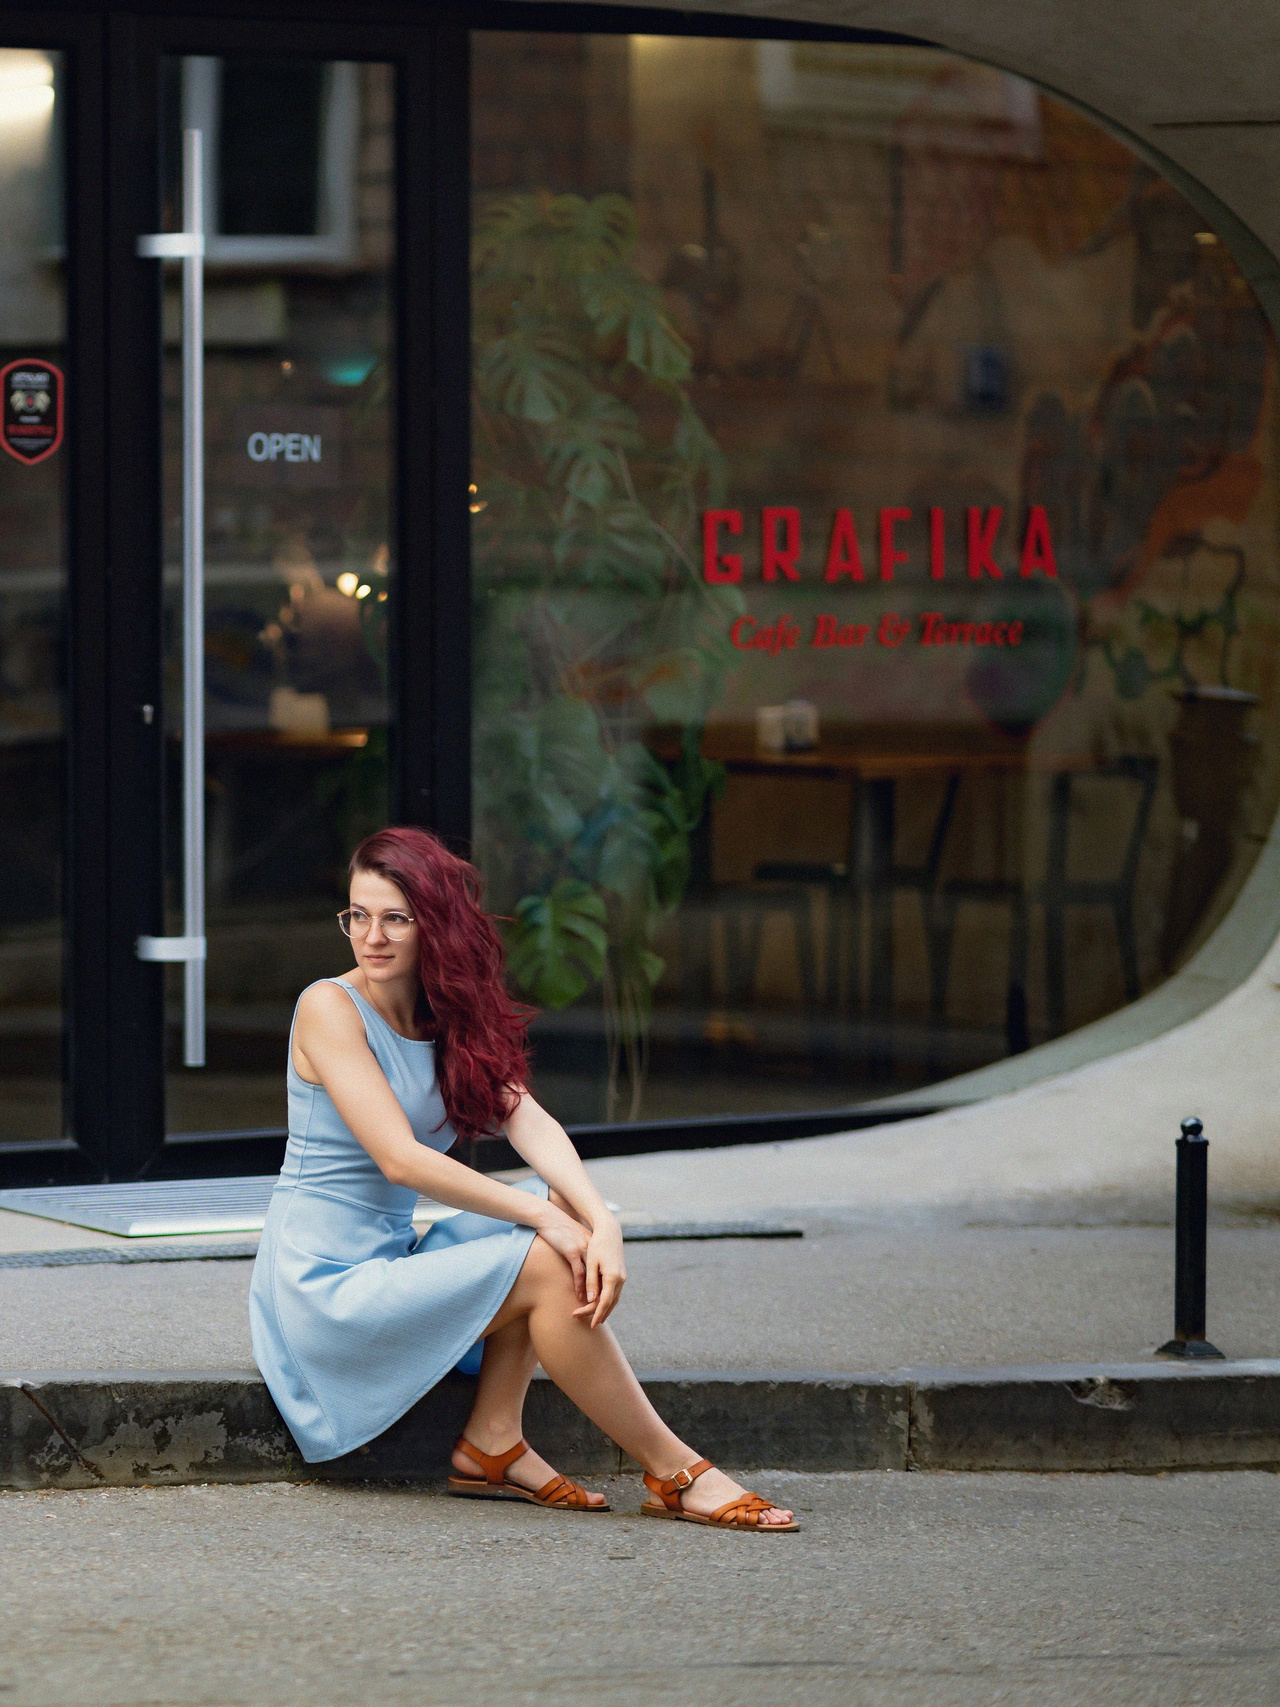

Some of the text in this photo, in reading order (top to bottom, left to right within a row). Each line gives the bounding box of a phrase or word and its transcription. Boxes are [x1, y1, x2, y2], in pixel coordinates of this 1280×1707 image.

[247, 431, 321, 462] OPEN
[703, 505, 1058, 584] GRAFIKA
[812, 613, 870, 648] Bar
[878, 611, 911, 648] &
[920, 612, 1024, 646] Terrace
